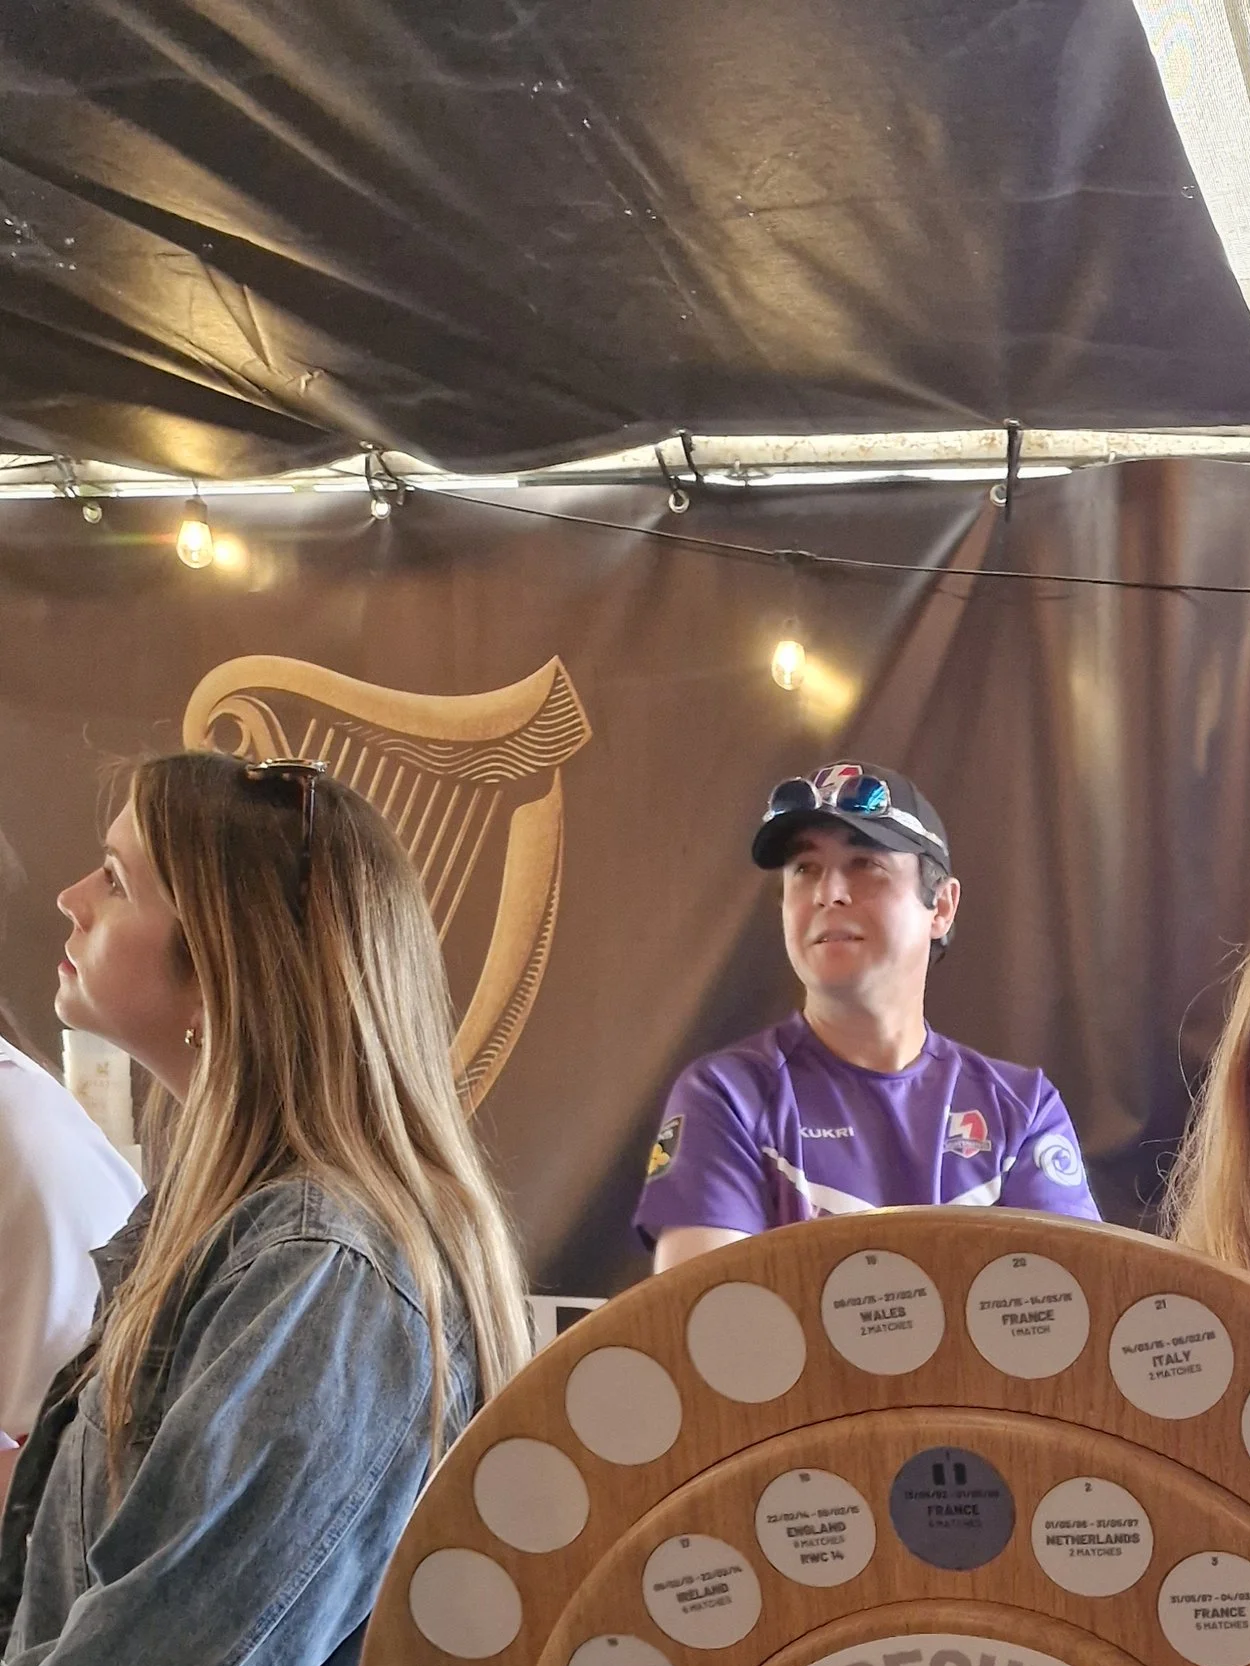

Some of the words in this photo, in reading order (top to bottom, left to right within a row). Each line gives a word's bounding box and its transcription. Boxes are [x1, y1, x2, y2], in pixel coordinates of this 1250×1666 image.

[800, 1125, 855, 1138] KUKRI
[1013, 1258, 1026, 1268] 20
[1155, 1299, 1167, 1309] 21
[860, 1307, 906, 1322] WALES
[1002, 1310, 1054, 1325] FRANCE
[867, 1320, 913, 1334] MATCHES
[1016, 1326, 1050, 1336] MATCH
[1152, 1350, 1191, 1367] ITALY
[1156, 1364, 1202, 1379] MATCHES
[928, 1505, 980, 1516] FRANCE
[786, 1522, 847, 1537] ENGLAND
[1046, 1533, 1140, 1545] NETHERLANDS
[1077, 1547, 1122, 1556] MATCHES
[800, 1552, 828, 1564] RWC
[676, 1583, 729, 1603] IRELAND
[1194, 1607, 1246, 1619] FRANCE
[1203, 1620, 1249, 1630] MATCHES
